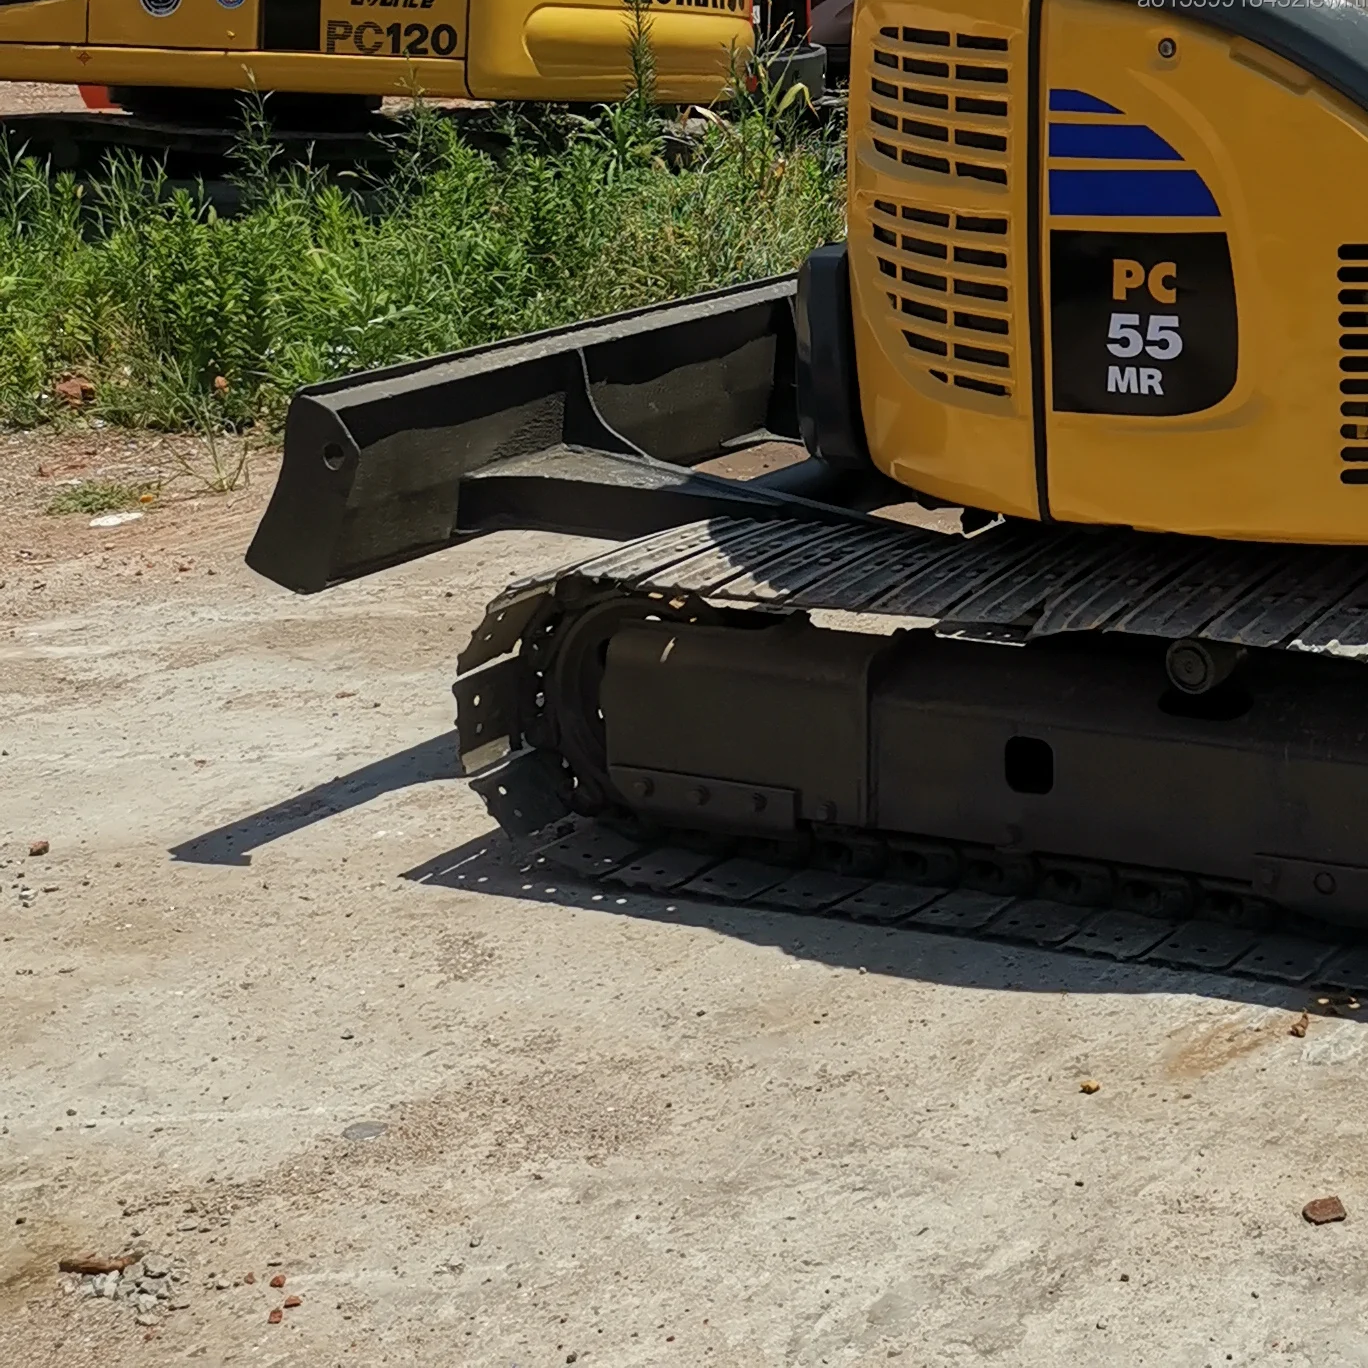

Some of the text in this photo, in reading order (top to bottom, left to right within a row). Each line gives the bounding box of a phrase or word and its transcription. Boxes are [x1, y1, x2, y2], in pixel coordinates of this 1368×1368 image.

[327, 20, 457, 55] PC120
[1112, 259, 1177, 304] PC
[1106, 313, 1183, 360] 55
[1107, 366, 1164, 395] MR
